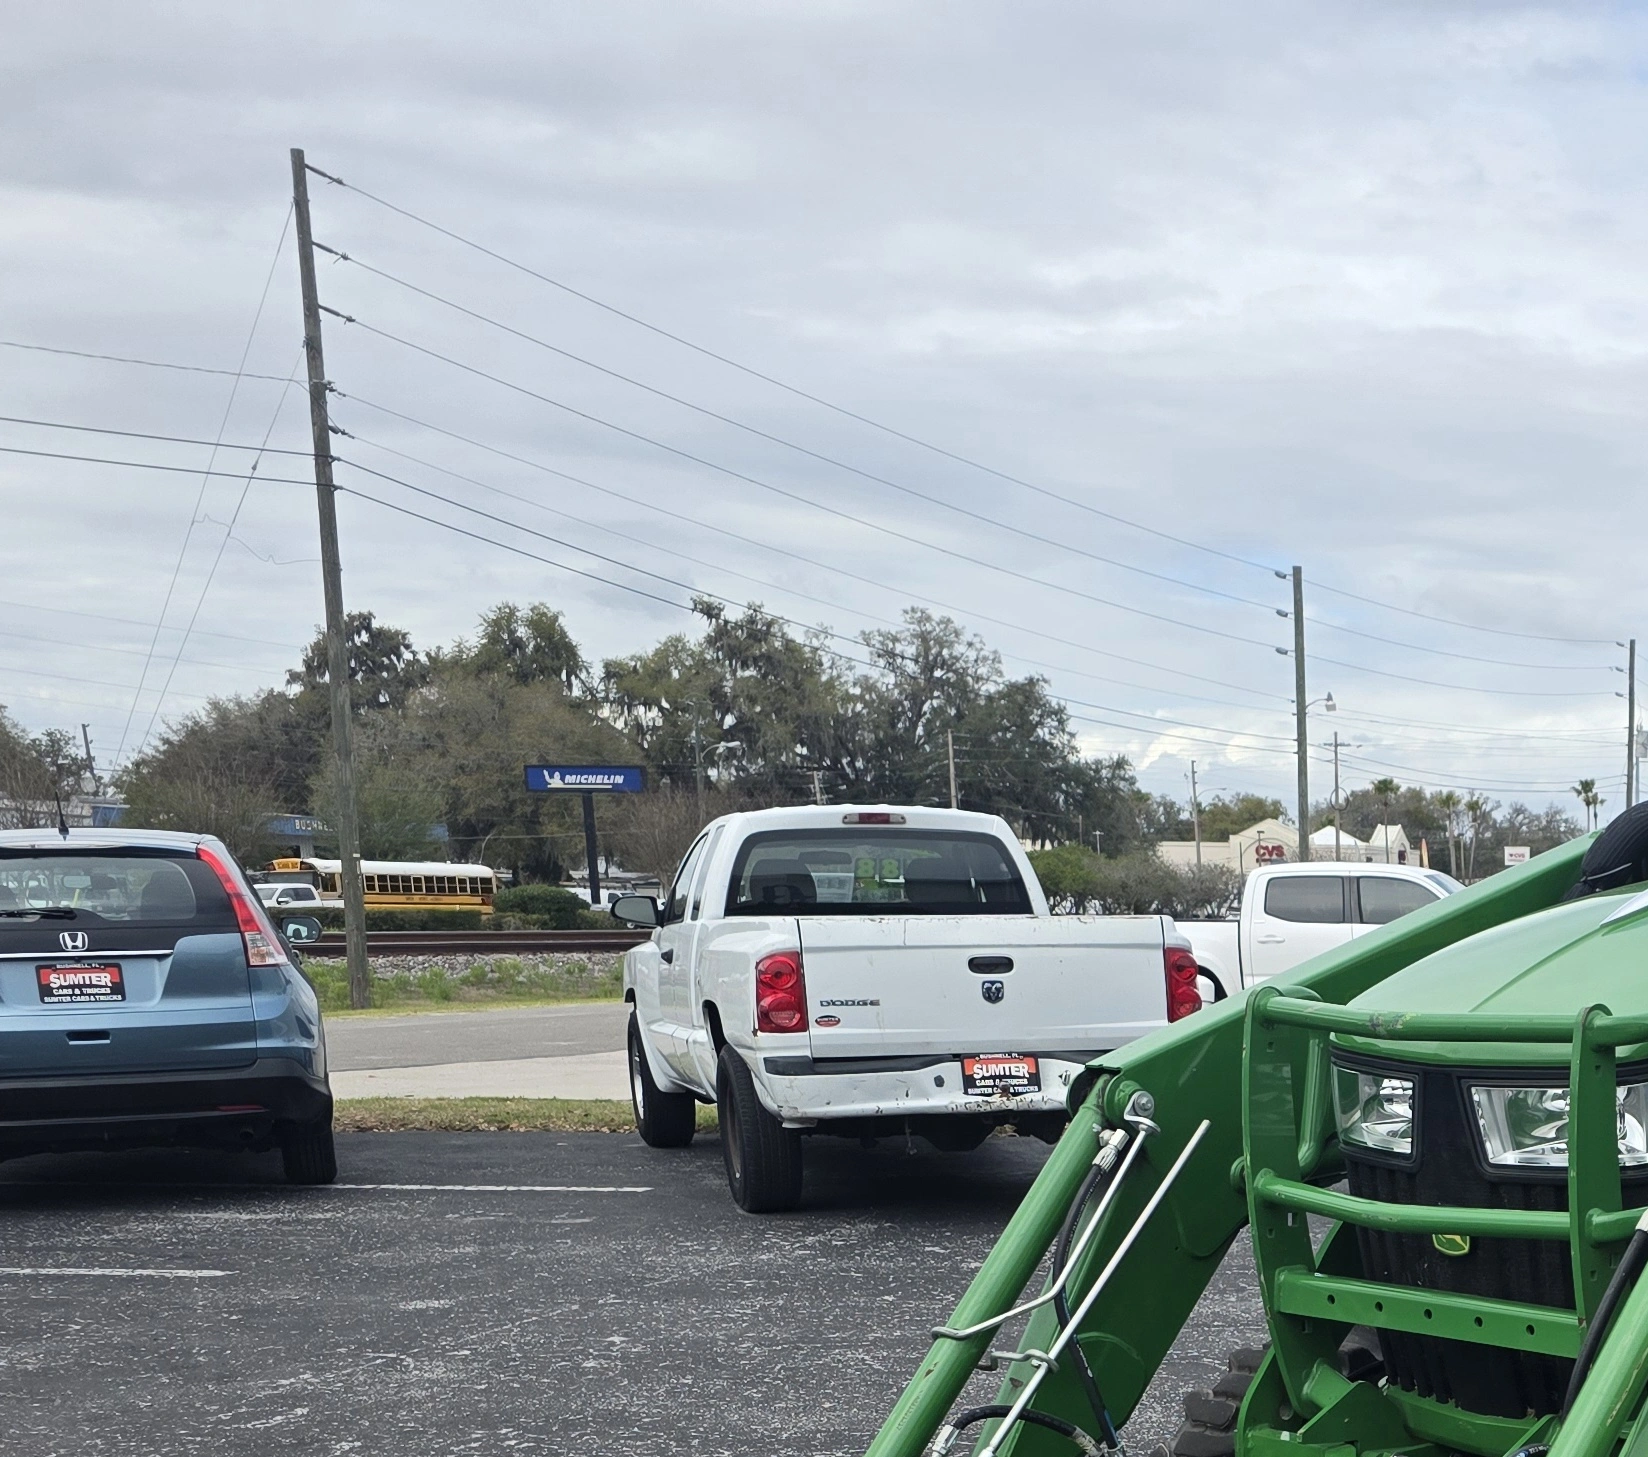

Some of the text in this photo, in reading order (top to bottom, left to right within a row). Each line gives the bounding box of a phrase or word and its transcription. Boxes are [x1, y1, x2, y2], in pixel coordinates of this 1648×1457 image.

[564, 774, 625, 784] MICHELIN
[294, 819, 339, 832] BUSHNE
[1255, 844, 1285, 858] CVS
[49, 972, 112, 988] SUMTER
[819, 999, 881, 1007] DODGE
[973, 1062, 1030, 1079] SUMTER
